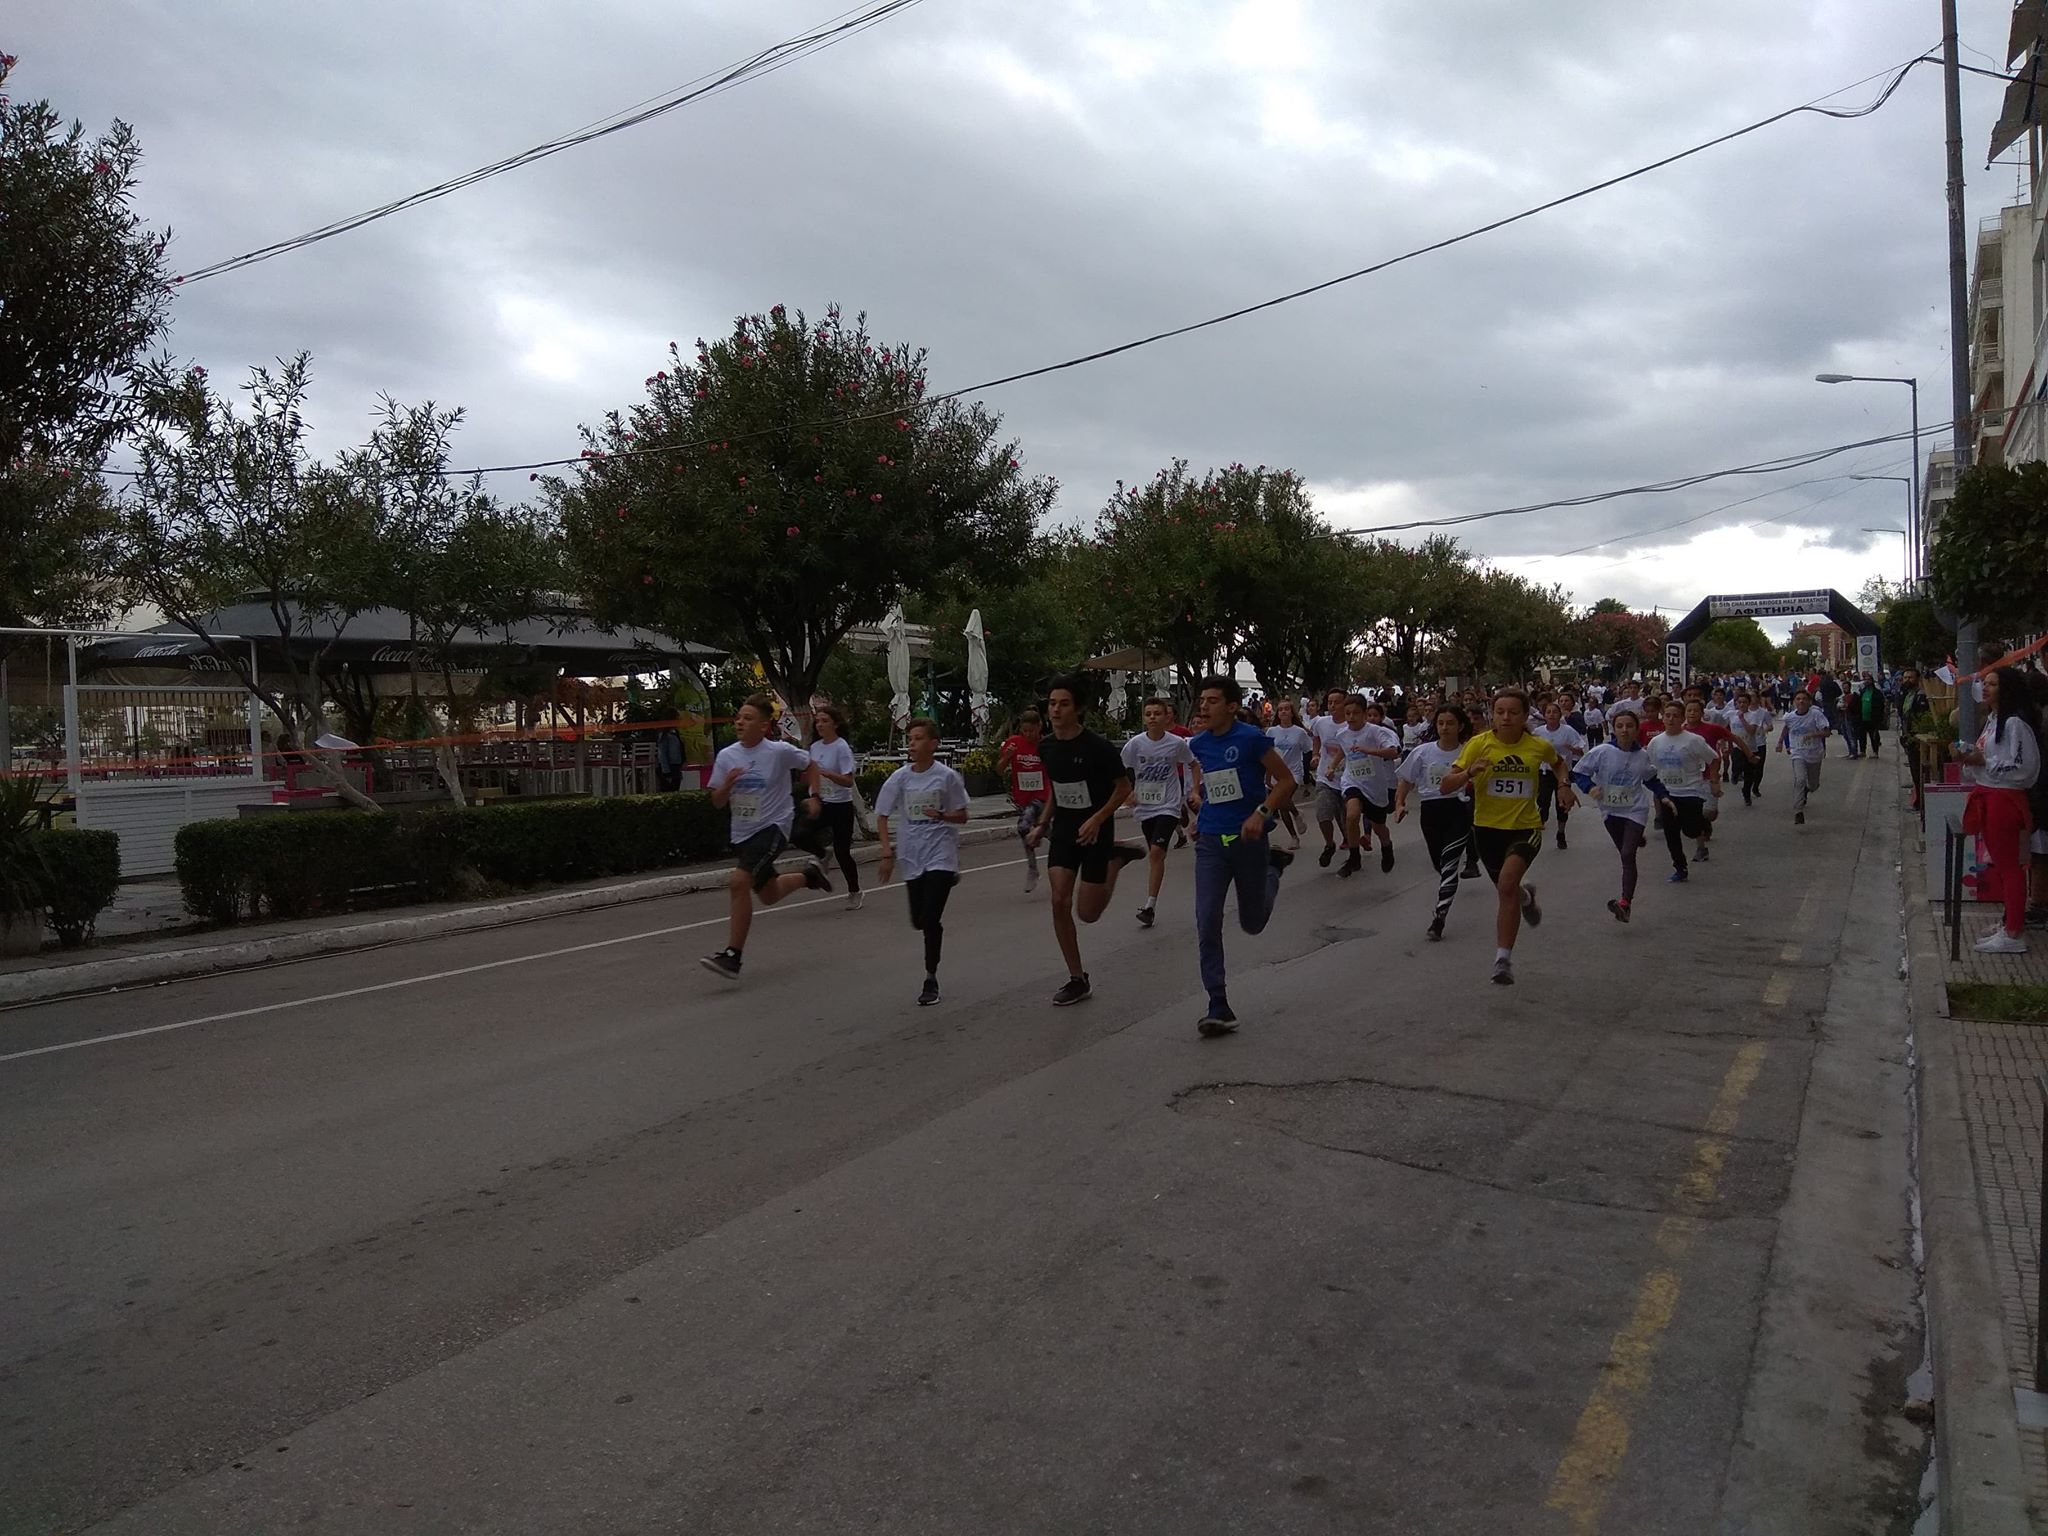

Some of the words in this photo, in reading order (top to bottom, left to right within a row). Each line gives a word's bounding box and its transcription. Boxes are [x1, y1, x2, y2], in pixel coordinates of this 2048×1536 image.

[1799, 596, 1829, 604] MARATHON
[1735, 606, 1804, 615] ΑΦΕΤΗΡΙΑ
[1492, 763, 1530, 773] adidas
[1209, 784, 1236, 798] 1020
[1495, 780, 1524, 794] 551
